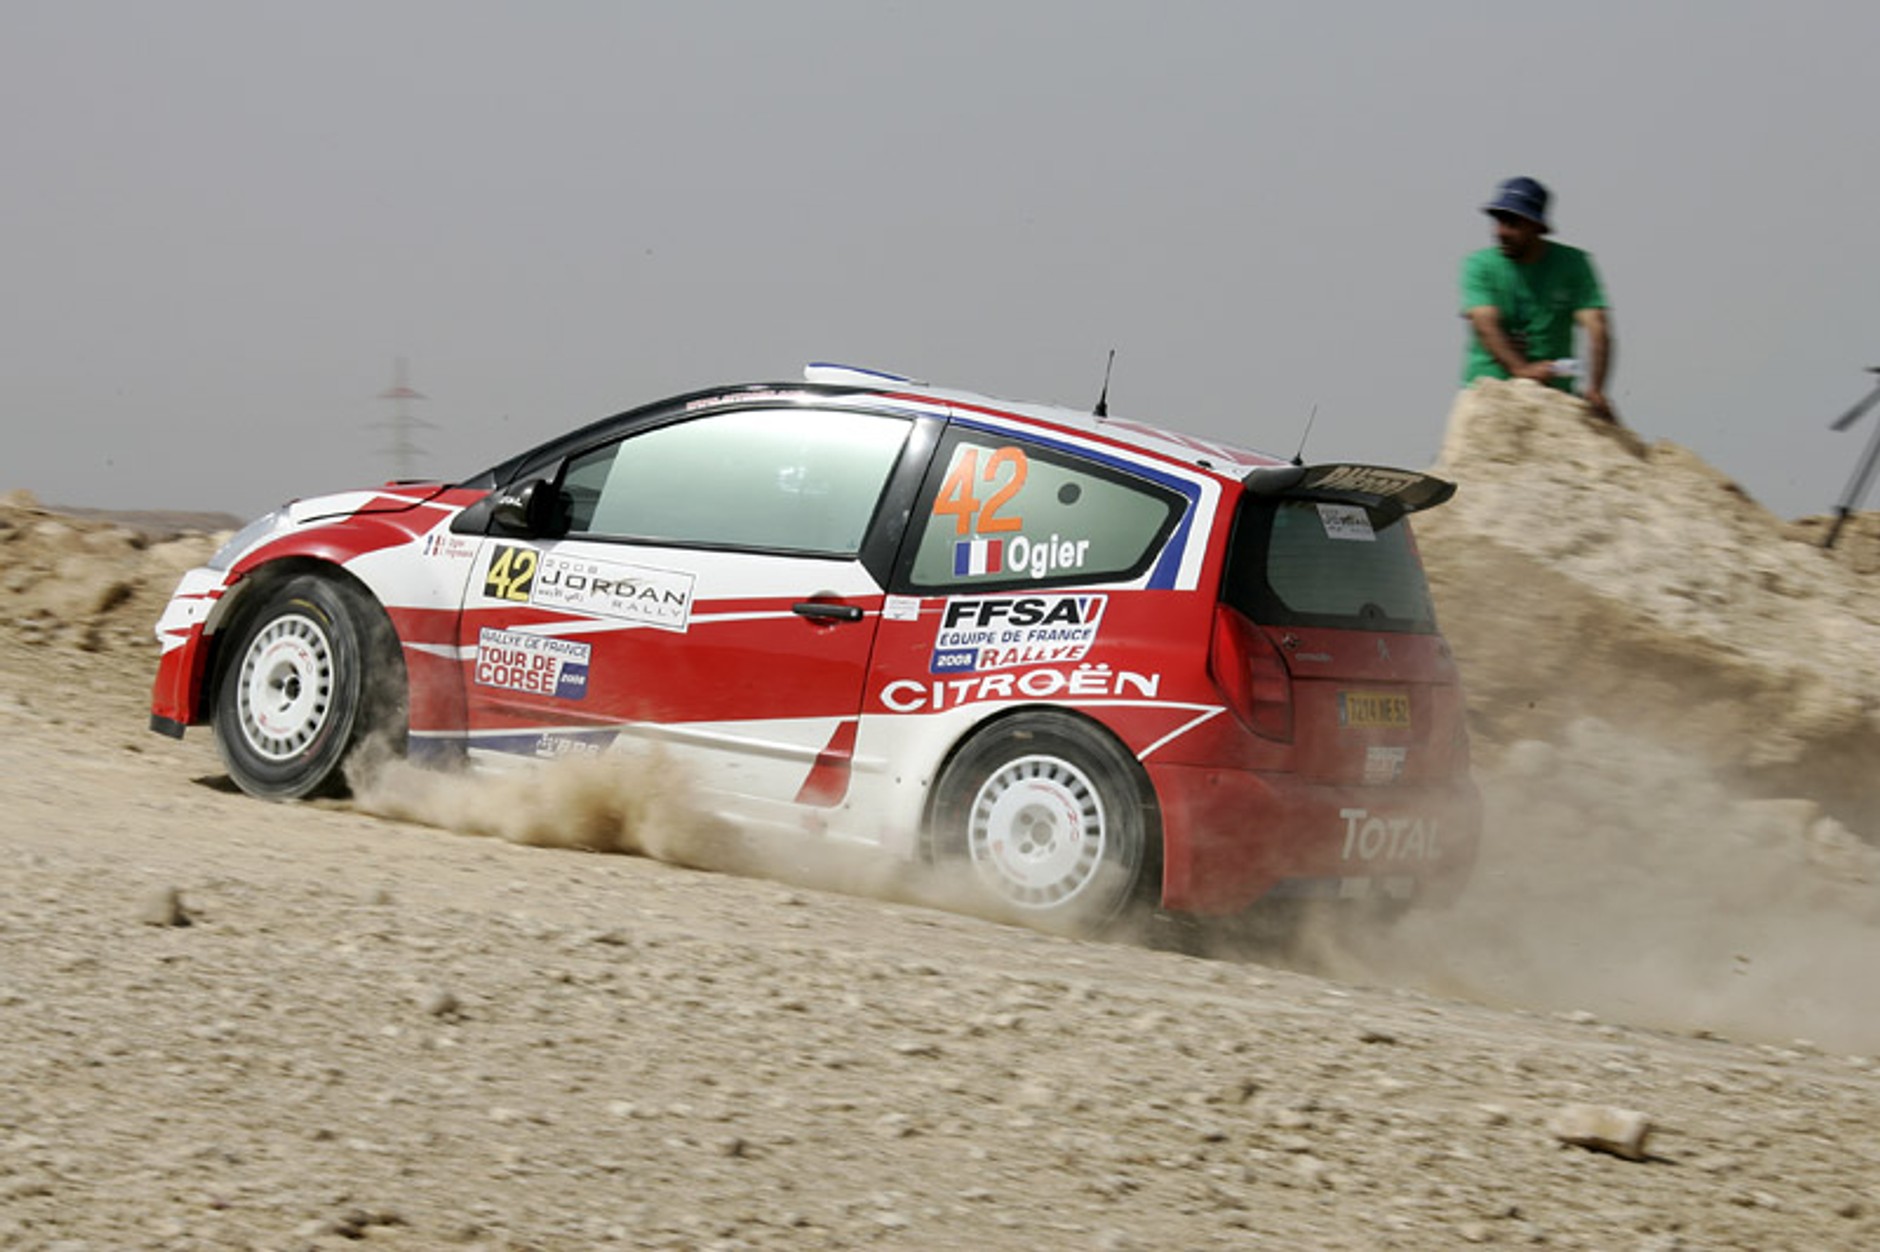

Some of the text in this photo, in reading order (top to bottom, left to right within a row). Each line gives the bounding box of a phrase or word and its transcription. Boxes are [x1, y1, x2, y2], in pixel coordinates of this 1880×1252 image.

[933, 446, 1028, 535] 42
[545, 559, 598, 574] 2008
[1007, 534, 1090, 578] Ogier
[487, 547, 538, 602] 42
[541, 570, 686, 605] JORDAN
[611, 600, 682, 617] RALLY
[944, 598, 1081, 628] FFSA
[1001, 630, 1022, 643] DE
[1026, 628, 1092, 642] FRANCE
[481, 646, 557, 673] TOUR DE
[979, 645, 1085, 668] RALLYE
[479, 662, 555, 692] CORSE
[880, 663, 1160, 712] CITROËN
